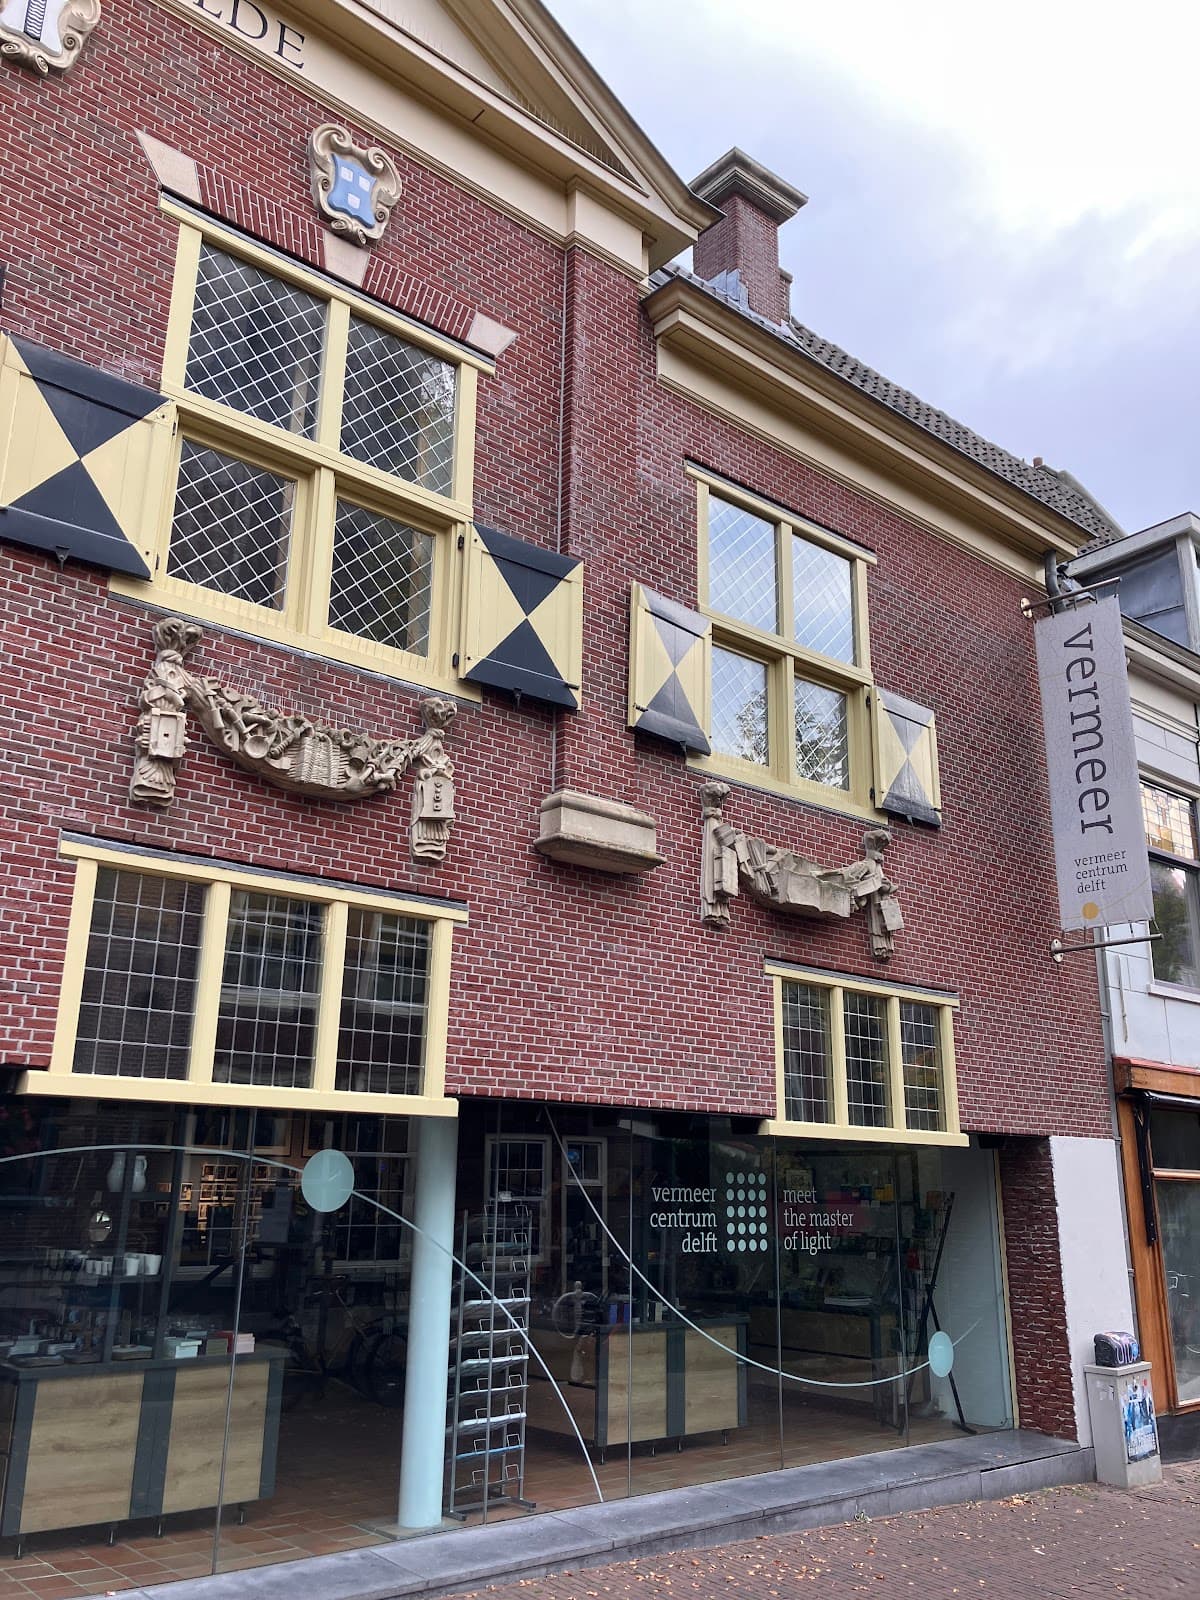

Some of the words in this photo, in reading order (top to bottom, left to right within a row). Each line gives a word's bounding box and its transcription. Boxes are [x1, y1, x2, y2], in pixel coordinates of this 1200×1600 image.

[1063, 622, 1114, 835] vermeer
[1074, 850, 1126, 867] vermeer
[1076, 863, 1128, 880] centrum
[1077, 879, 1106, 894] delft
[652, 1187, 717, 1203] vermeer
[784, 1186, 817, 1204] meet
[650, 1208, 718, 1228] centrum
[784, 1208, 806, 1227] the
[809, 1211, 854, 1227] master
[682, 1232, 718, 1253] delft
[784, 1231, 798, 1250] of
[801, 1231, 832, 1256] light
